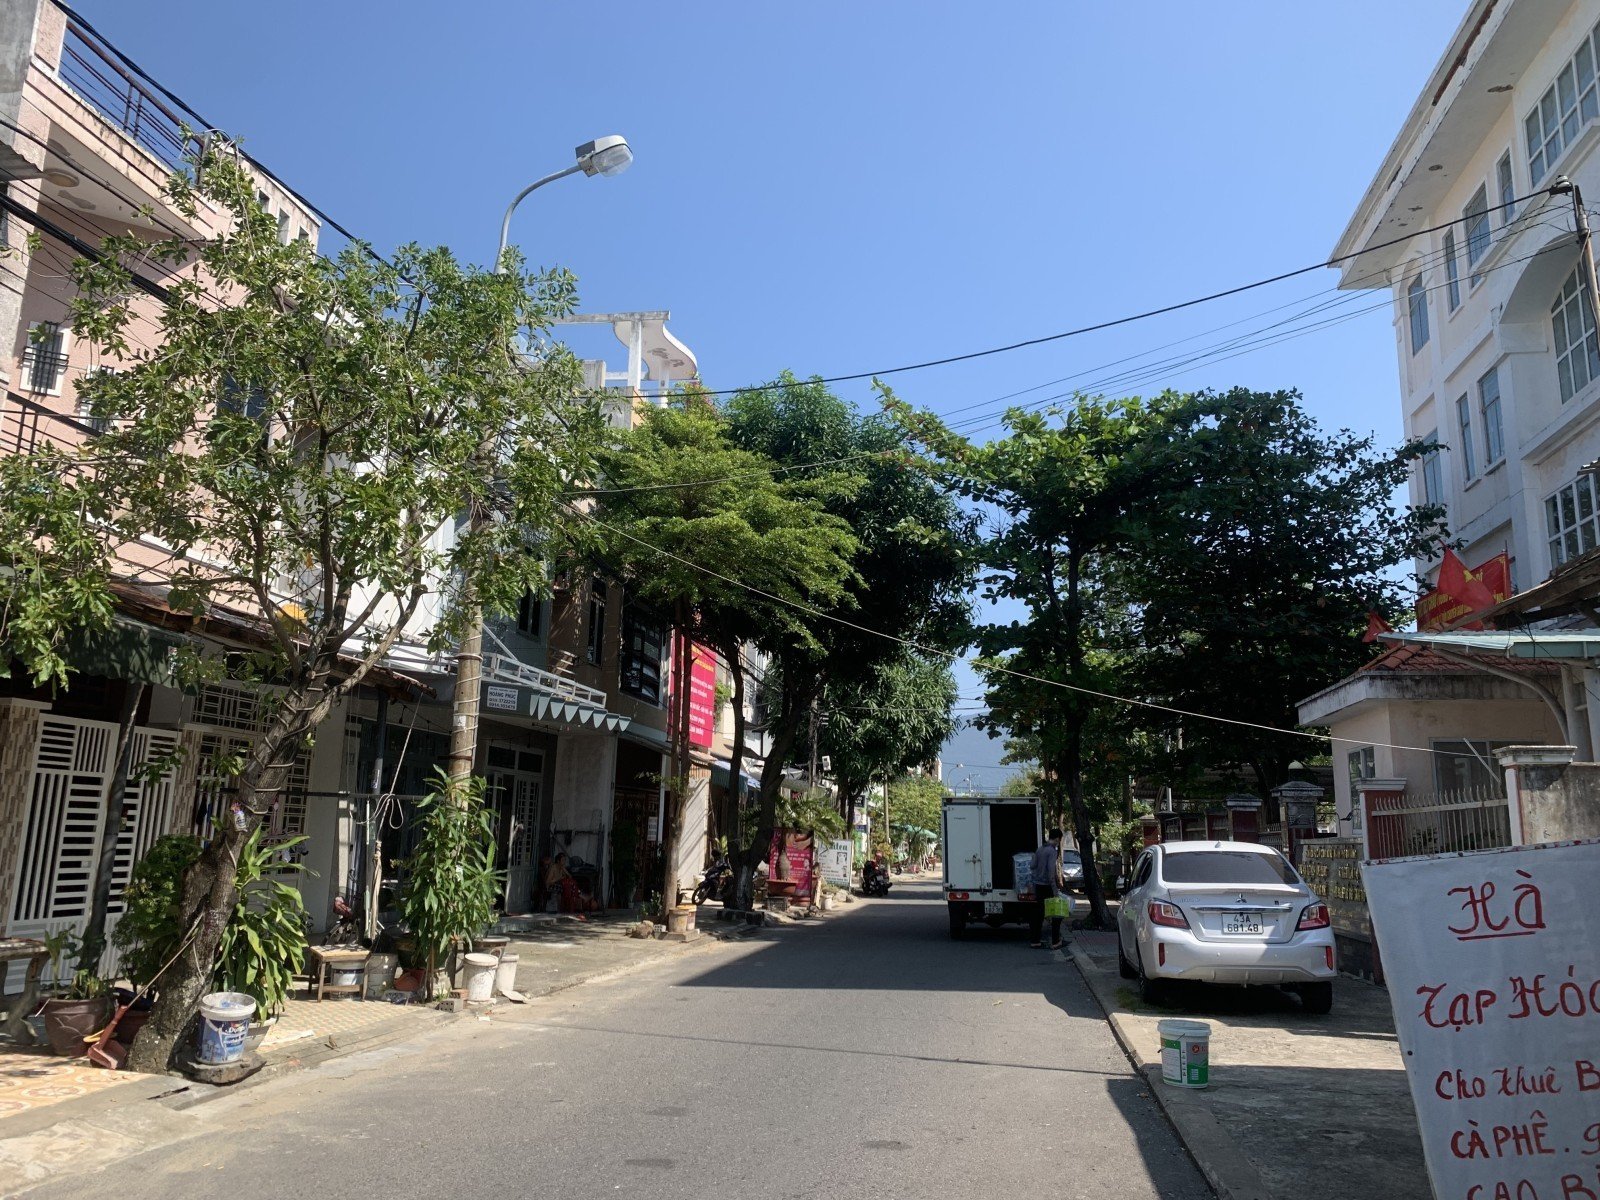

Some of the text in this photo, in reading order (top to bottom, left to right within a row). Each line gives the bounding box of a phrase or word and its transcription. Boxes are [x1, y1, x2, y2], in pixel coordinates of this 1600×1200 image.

[1447, 869, 1546, 934] Hà
[1227, 923, 1259, 933] 681.48
[1233, 914, 1251, 923] 43A
[1435, 1069, 1486, 1100] Cho
